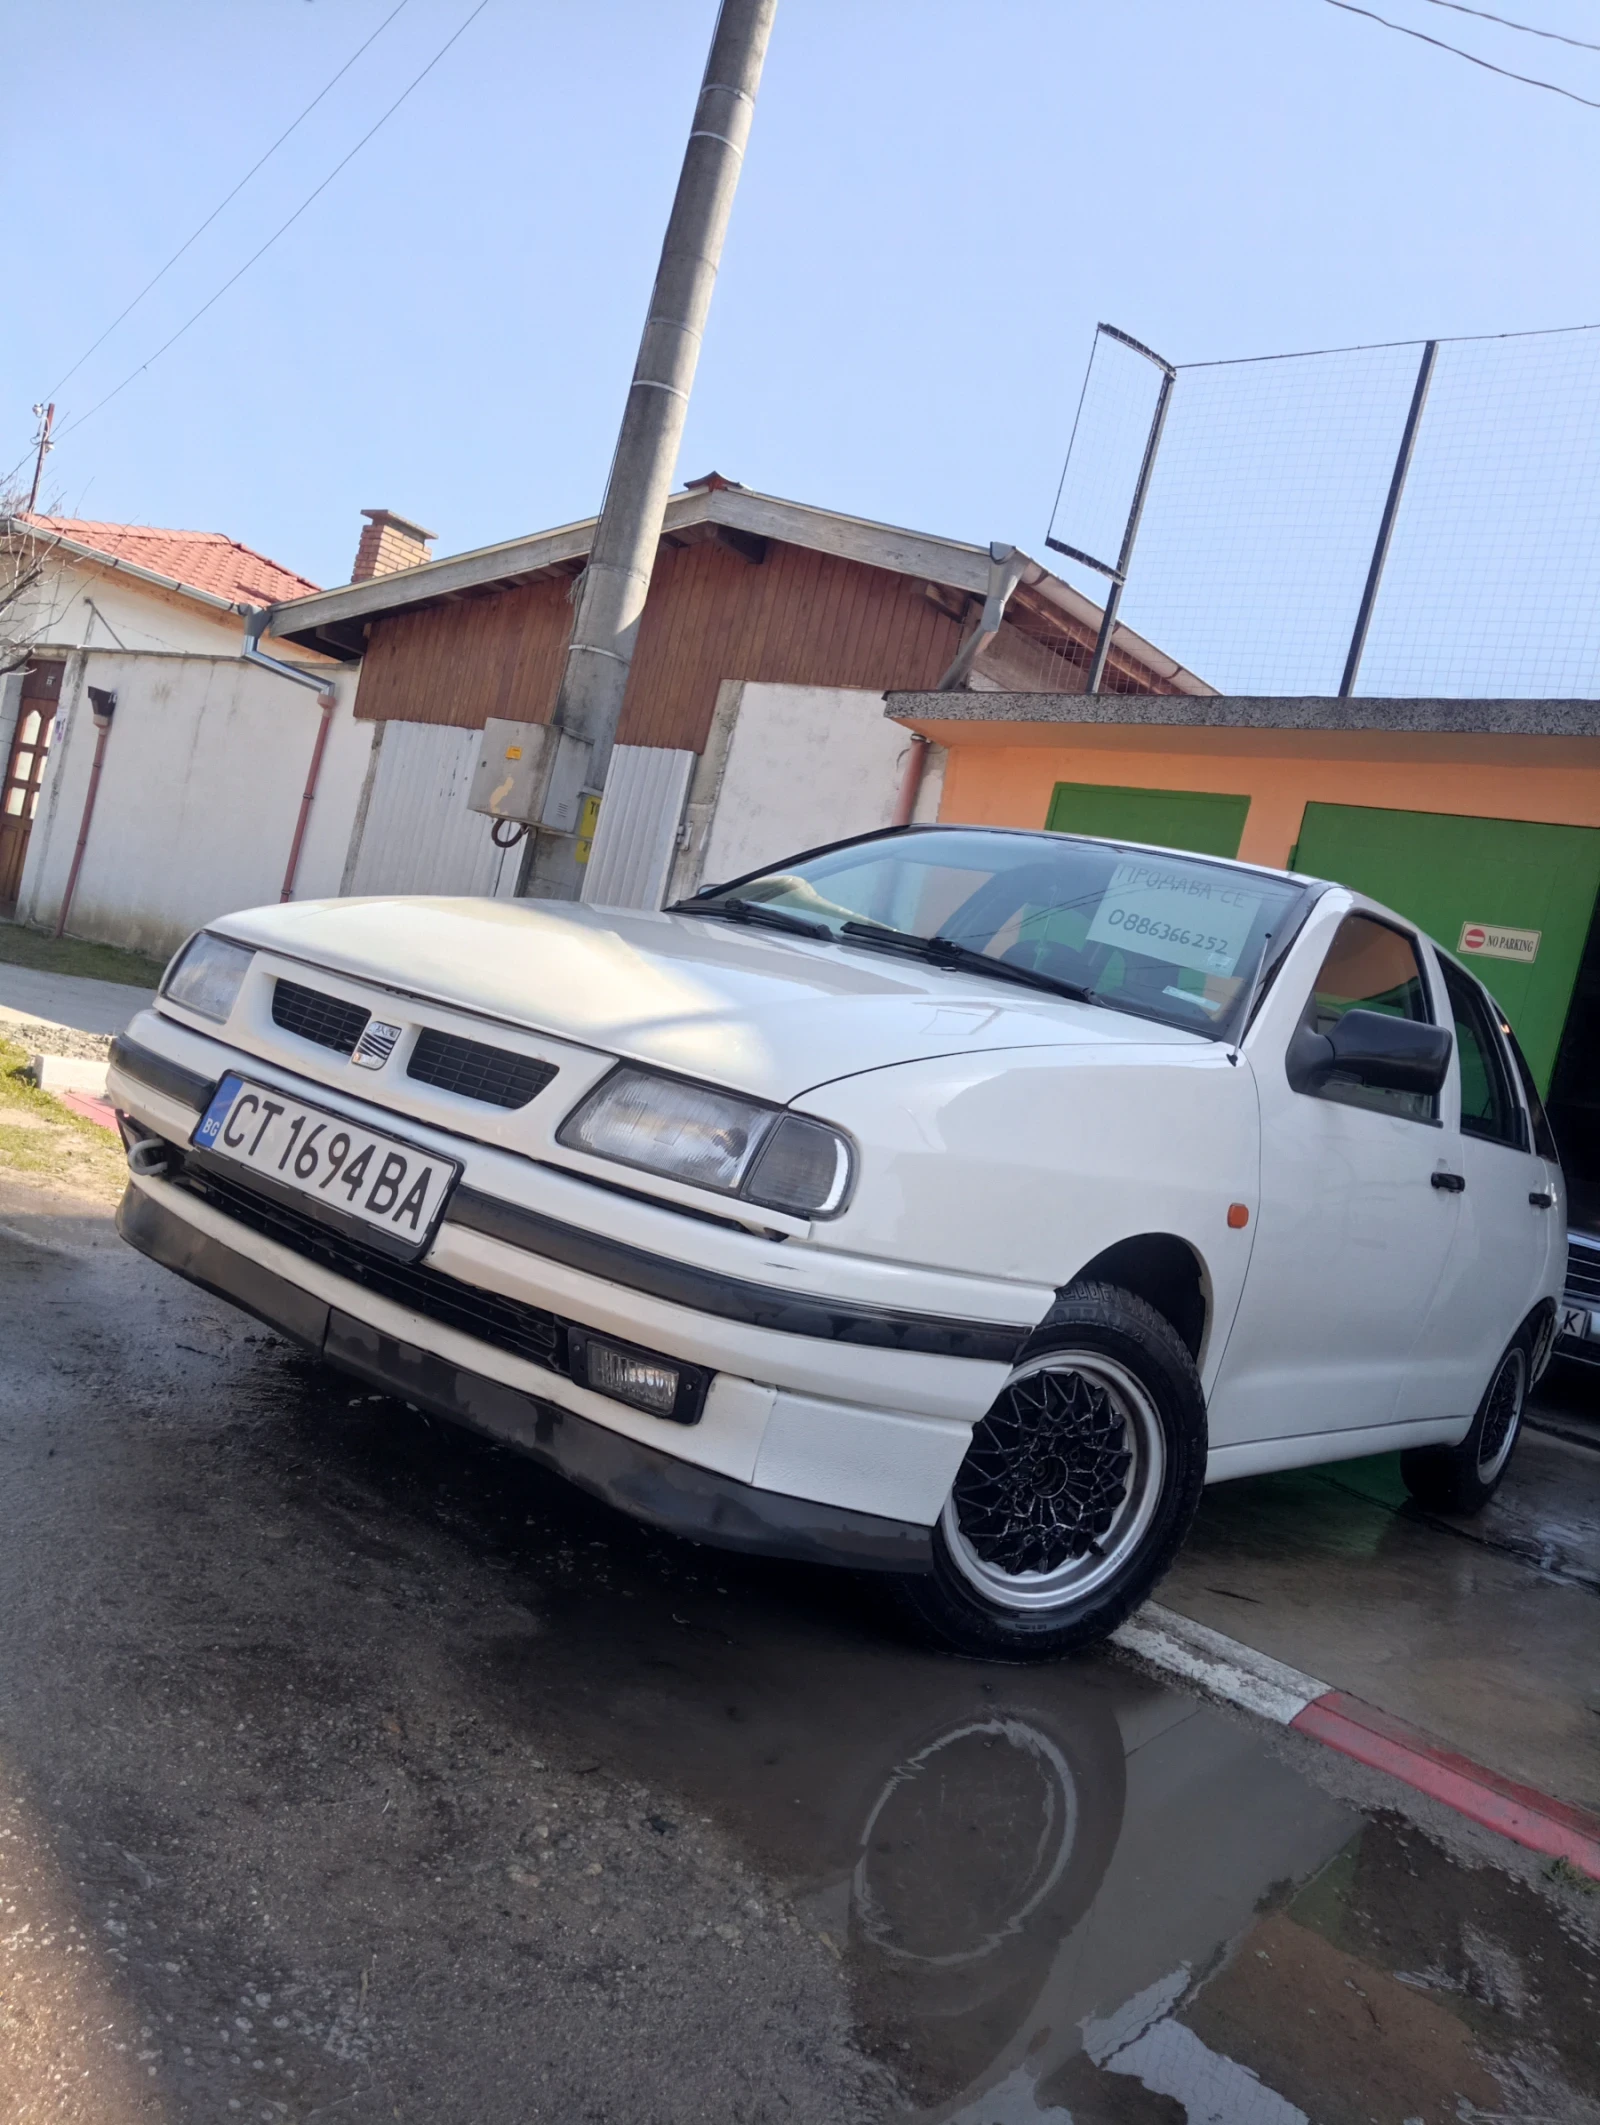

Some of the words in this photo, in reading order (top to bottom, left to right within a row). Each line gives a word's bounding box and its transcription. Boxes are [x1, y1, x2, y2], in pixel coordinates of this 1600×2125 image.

[1117, 865, 1211, 900] ПРОДАВА
[1108, 909, 1228, 955] 0886366252
[1487, 935, 1499, 948] NO
[1500, 936, 1534, 952] PARKING
[202, 1117, 220, 1137] BG
